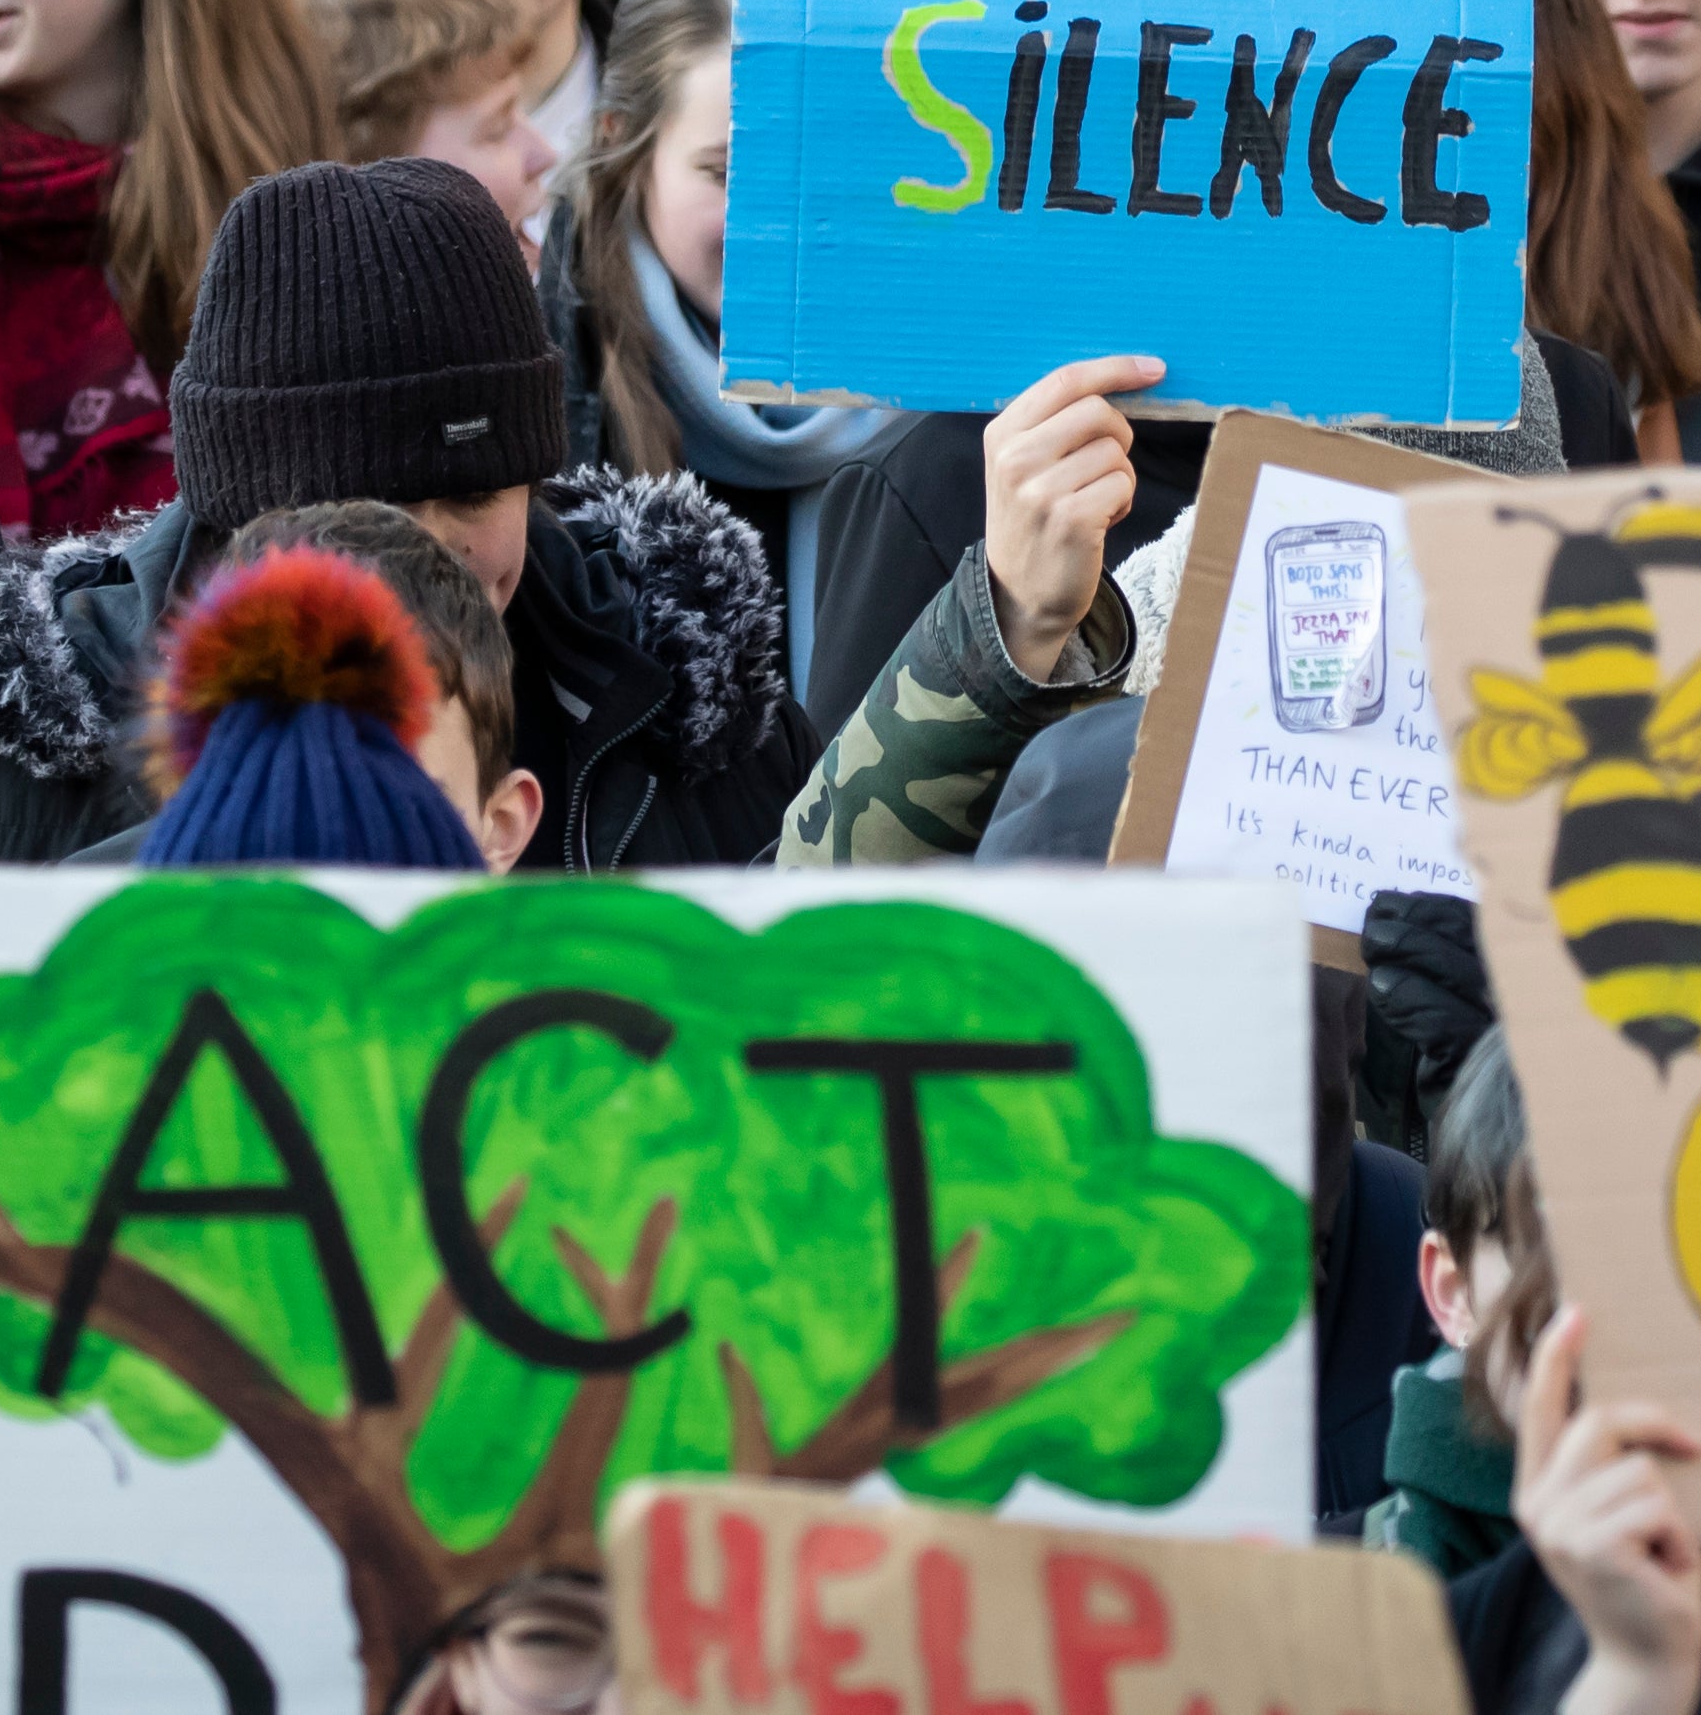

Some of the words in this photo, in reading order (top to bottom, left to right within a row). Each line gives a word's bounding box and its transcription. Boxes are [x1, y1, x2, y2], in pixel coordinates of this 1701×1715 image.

[1241, 746, 1338, 792] THAN
[1349, 768, 1451, 819] EVER
[1291, 818, 1376, 864] kinda
[36, 984, 1080, 1434] ACT
